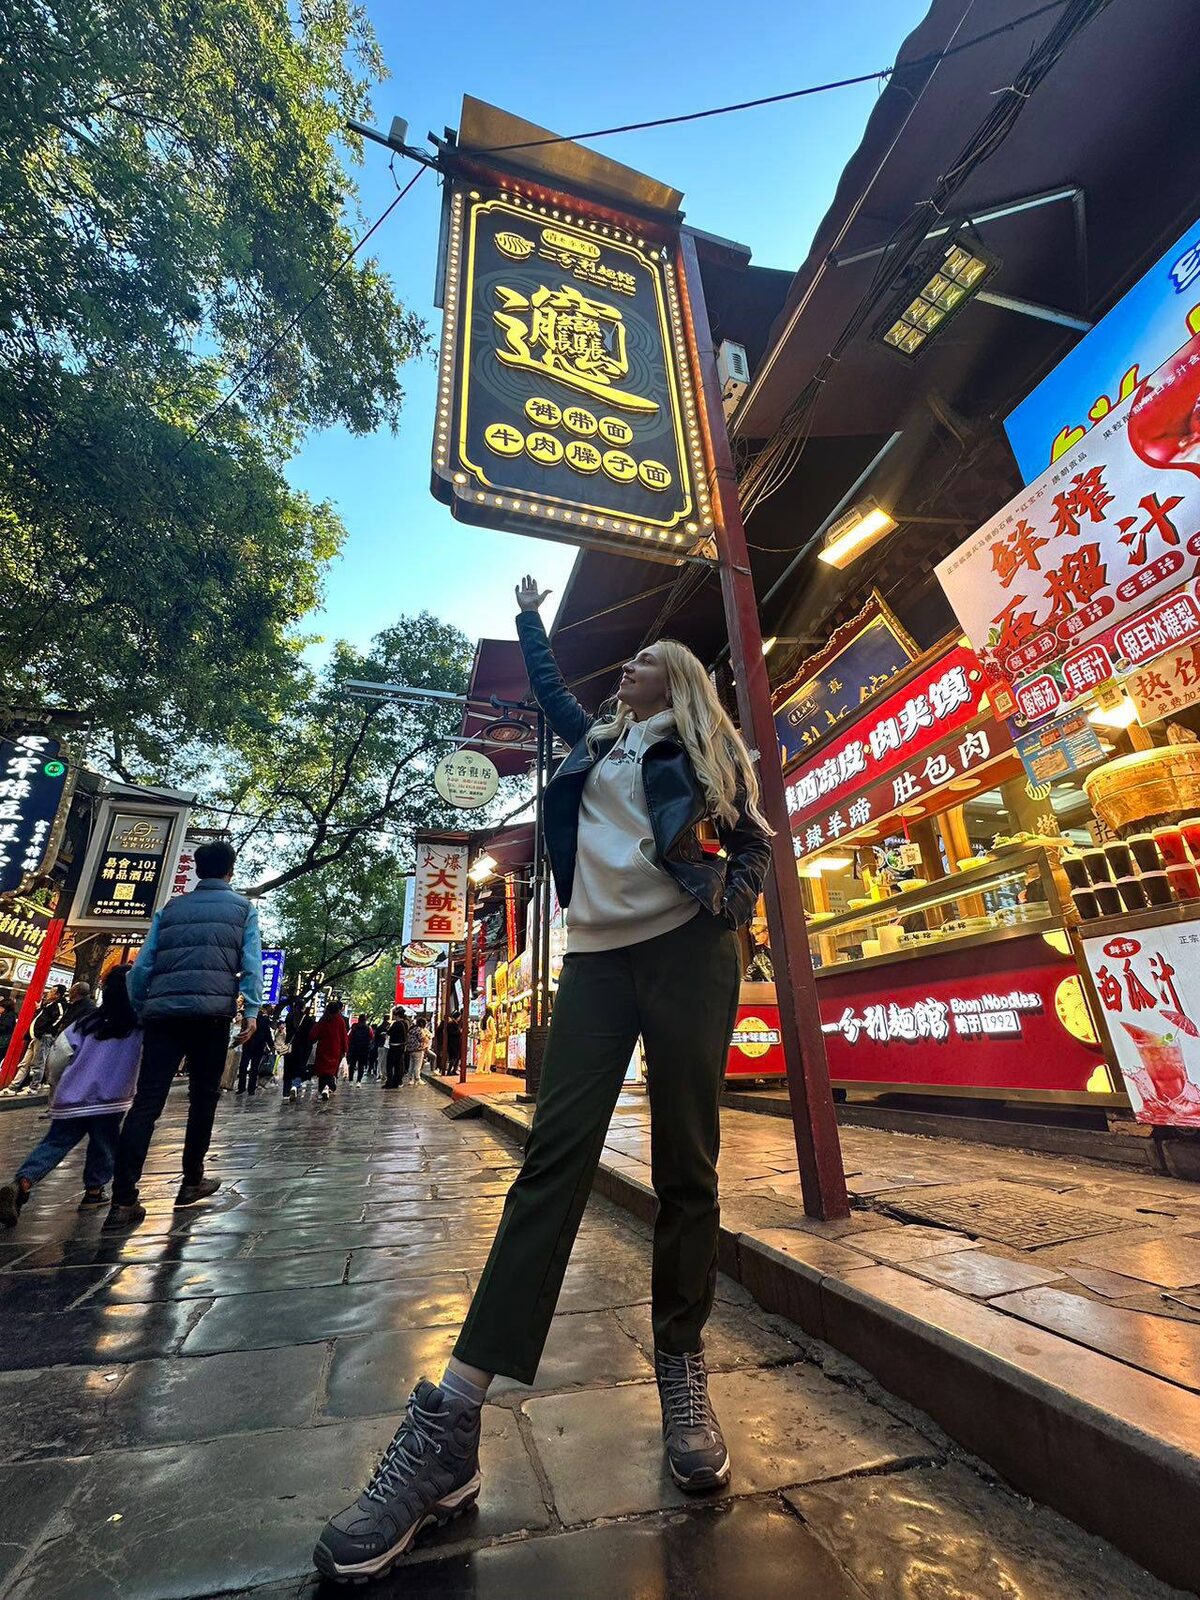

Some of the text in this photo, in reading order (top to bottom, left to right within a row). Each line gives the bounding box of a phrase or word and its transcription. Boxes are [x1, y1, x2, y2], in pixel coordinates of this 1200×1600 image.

[490, 428, 668, 484] 牛肉臊子面
[989, 464, 1116, 589] 鲜榨
[1119, 556, 1176, 597] 芒果汁
[1066, 603, 1103, 633] 橙汁
[1121, 598, 1200, 661] 银耳冰糖梨
[1066, 650, 1107, 690] 草莓汁
[1020, 680, 1057, 718] 酸梅汤
[1158, 687, 1200, 714] 免费加
[892, 730, 991, 807] 肚包肉
[101, 868, 156, 882] 精品酒店
[421, 852, 463, 871] 火爆
[424, 867, 458, 935] 大鱿鱼
[950, 990, 1042, 1013] Boon Noodles
[1096, 951, 1185, 1016] 西瓜汁
